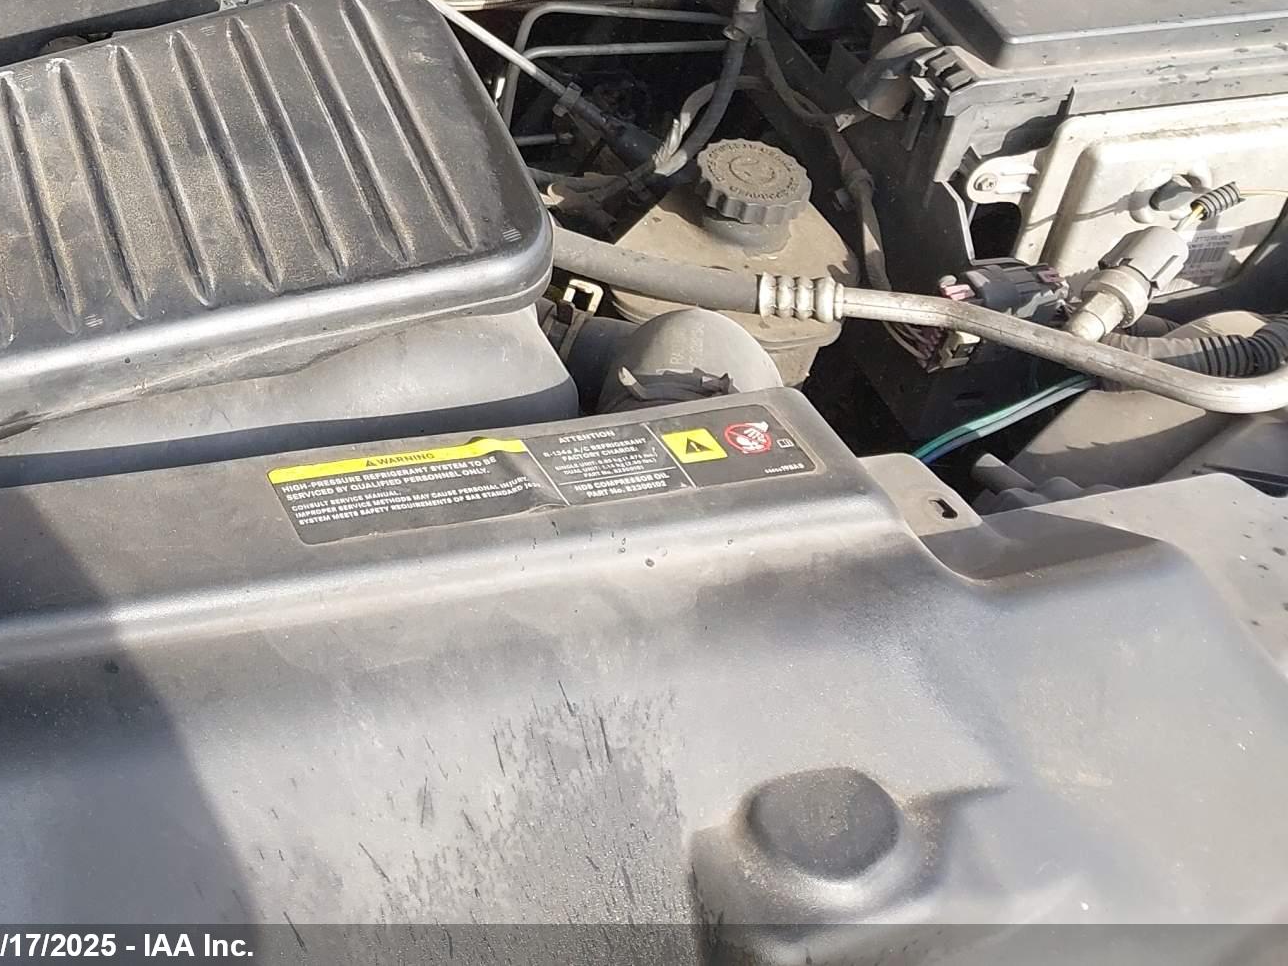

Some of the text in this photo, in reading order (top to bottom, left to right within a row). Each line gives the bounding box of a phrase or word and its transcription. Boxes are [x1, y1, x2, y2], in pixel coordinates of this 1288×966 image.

[559, 430, 616, 444] ATTENTION
[573, 445, 590, 455] A/C
[590, 437, 646, 452] REFRIGERANT
[376, 452, 435, 465] WARNING
[561, 452, 600, 462] FACTORY
[281, 456, 497, 494] HIGH-PRESSURE REFRIGERANT SYSTEM TO BE
[593, 474, 653, 489] COMPRESSOR
[653, 472, 670, 480] OIL
[286, 467, 490, 501] SERVICED BY QUALIFIED PERSONNEL ONLY.
[586, 490, 608, 498] PART
[611, 487, 626, 495] No.
[292, 500, 329, 512] CONSULT
[330, 495, 363, 505] SERVICE
[295, 507, 337, 519] IMPROPER
[338, 501, 372, 512] SERVICE
[372, 495, 412, 507] METHODS
[413, 493, 429, 501] MAY
[431, 489, 458, 499] CAUSE
[458, 483, 499, 495] PERSONAL
[298, 514, 331, 525] SYSTEM
[331, 511, 359, 521] MEETS
[360, 506, 389, 517] SAFETY
[392, 497, 453, 511] REQUIREMENTS
[453, 495, 464, 503] OF
[482, 485, 523, 499] STANDARD
